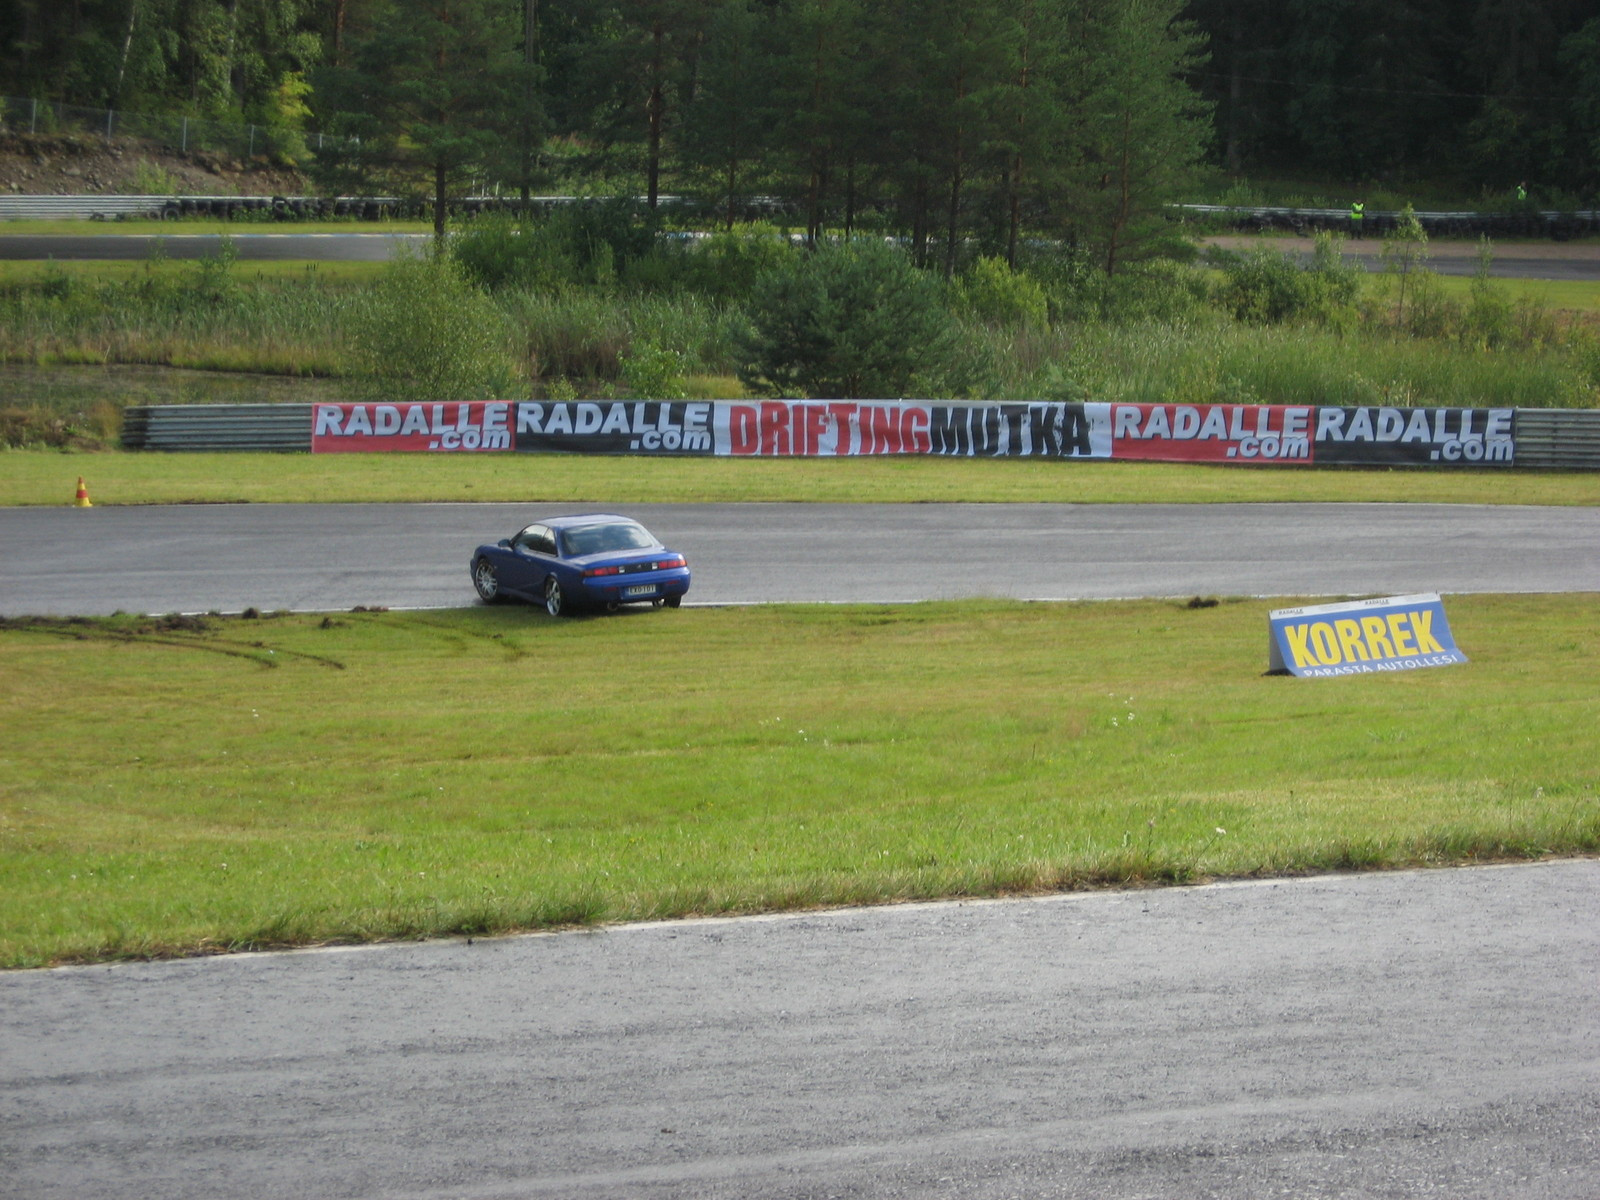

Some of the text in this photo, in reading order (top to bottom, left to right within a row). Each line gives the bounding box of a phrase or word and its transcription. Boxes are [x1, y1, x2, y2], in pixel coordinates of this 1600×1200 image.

[315, 403, 509, 436] RADALLE
[516, 402, 711, 434] RADALLE
[1114, 406, 1311, 441] RADALLE
[1315, 407, 1514, 443] RADALLE
[428, 429, 511, 449] .com
[629, 430, 711, 450] .com
[1226, 436, 1311, 458] .com
[1430, 438, 1515, 460] .com
[1284, 610, 1446, 668] KORREK
[1303, 654, 1458, 677] PARASTA AUTOLLESI
